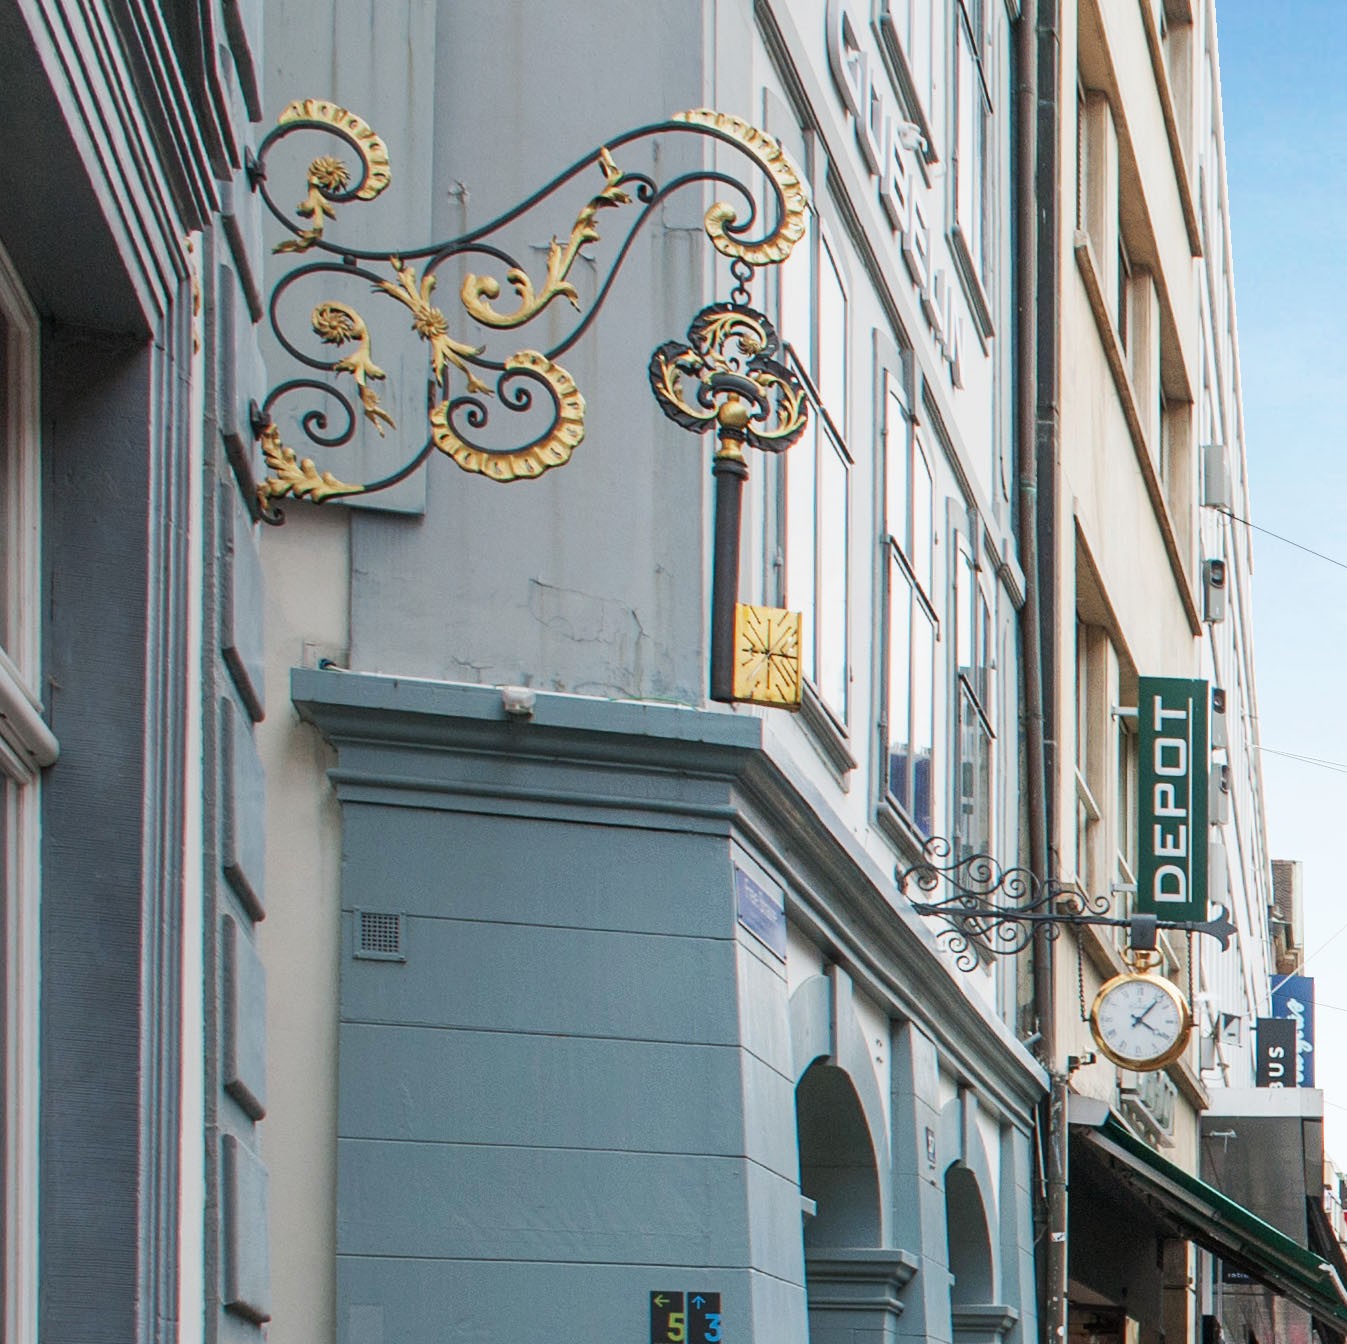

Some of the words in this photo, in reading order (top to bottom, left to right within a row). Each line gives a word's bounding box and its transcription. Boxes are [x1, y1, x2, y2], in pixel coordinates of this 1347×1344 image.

[1154, 695, 1187, 903] DEPOT
[668, 1312, 684, 1342] 5
[704, 1313, 722, 1342] 3
